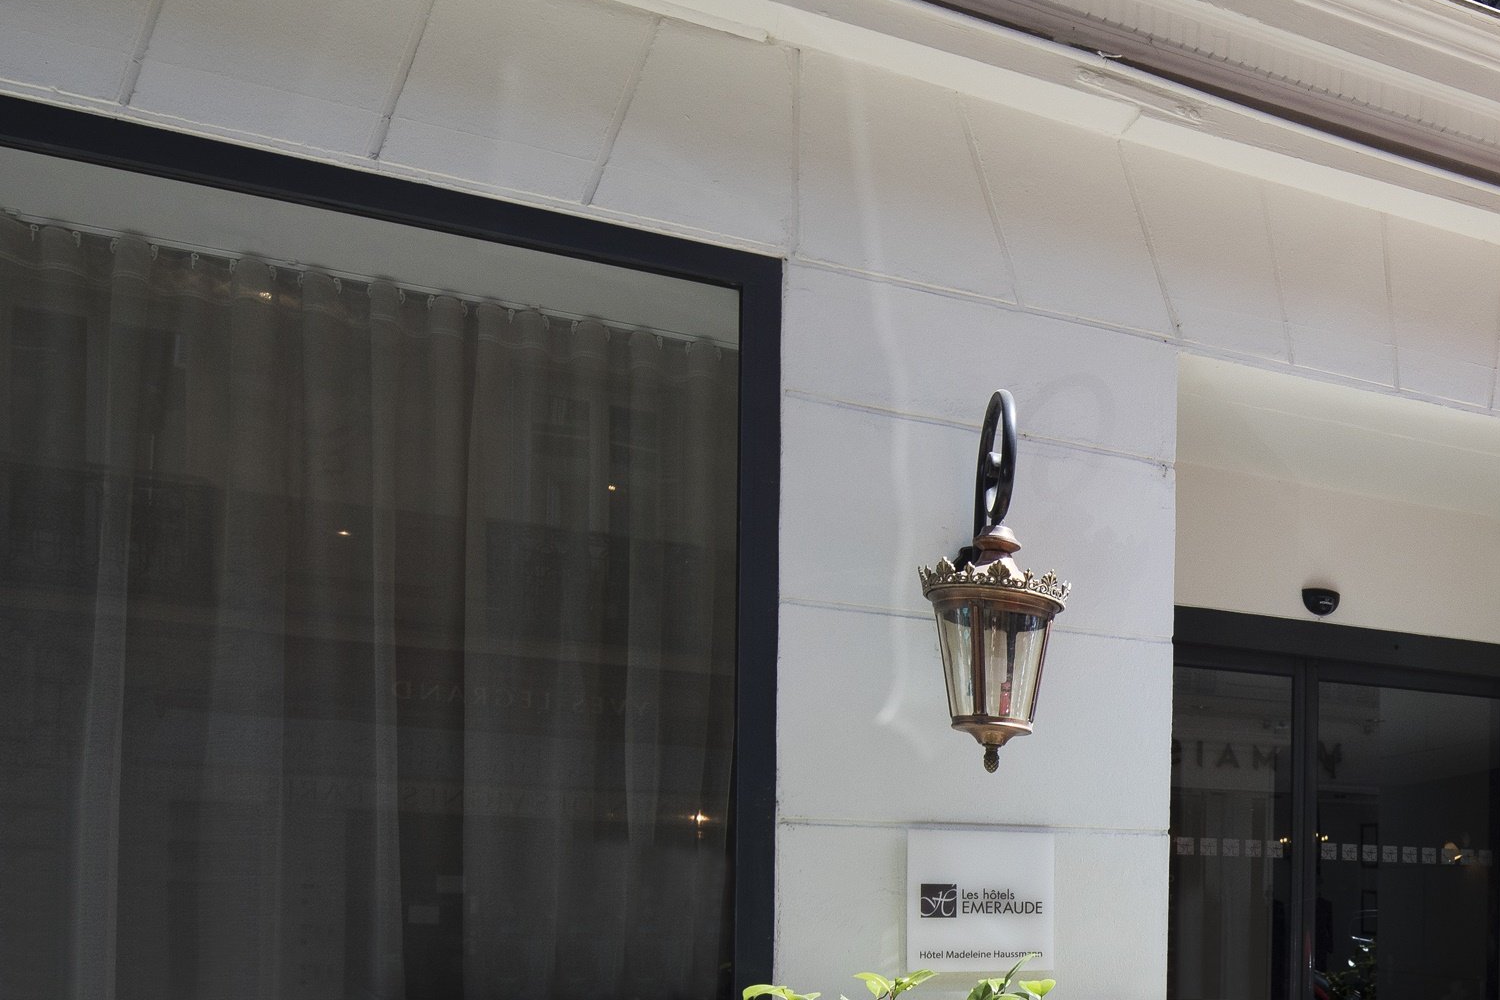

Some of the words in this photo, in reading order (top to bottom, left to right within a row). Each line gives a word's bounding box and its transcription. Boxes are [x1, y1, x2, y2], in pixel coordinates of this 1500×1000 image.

[961, 889, 978, 900] Les
[983, 888, 1015, 900] hôtels
[961, 901, 1043, 914] EMERAUDE
[920, 950, 944, 959] Hôtel
[946, 950, 991, 959] Madeleine
